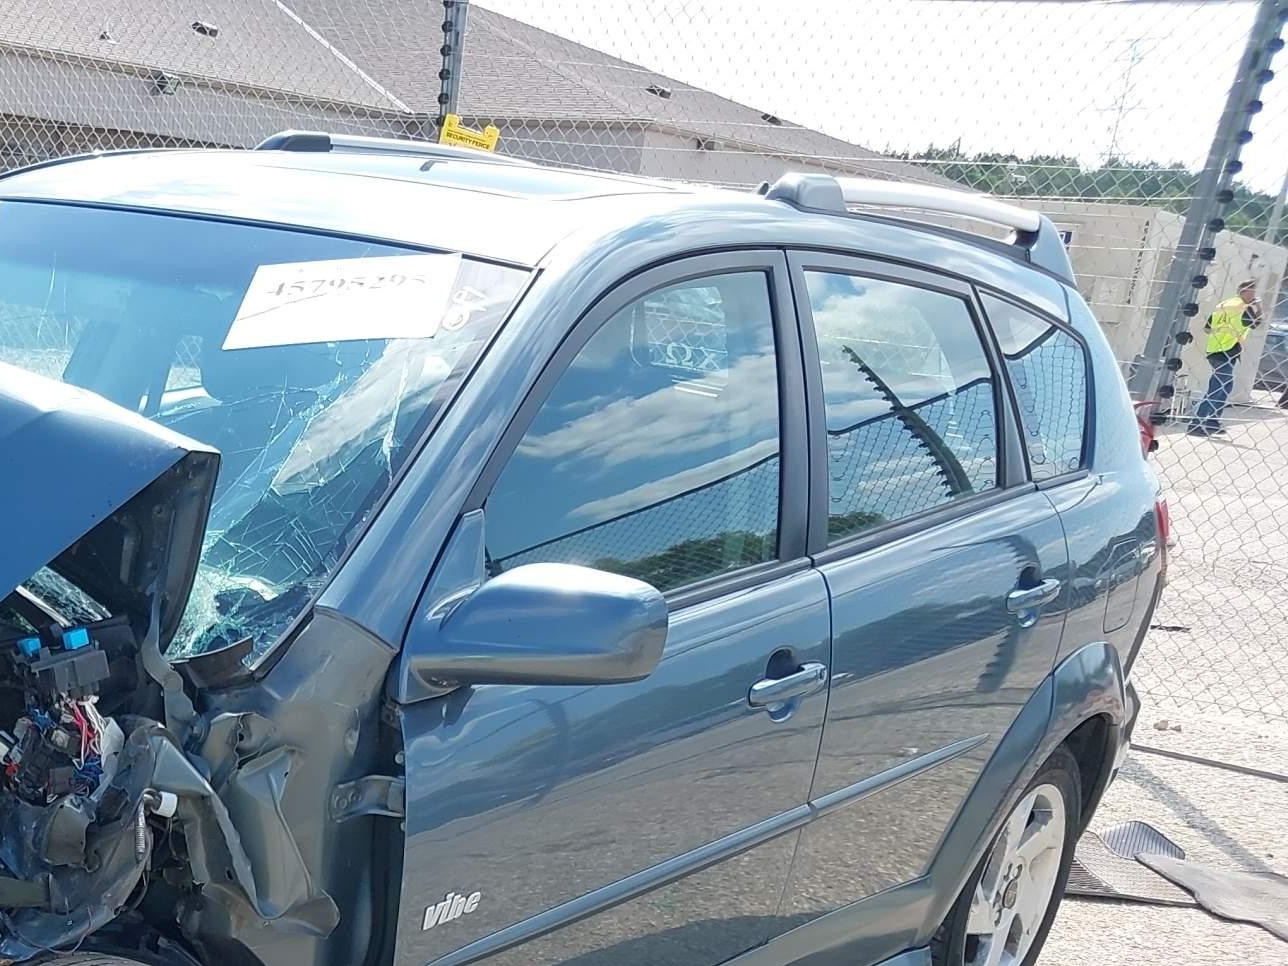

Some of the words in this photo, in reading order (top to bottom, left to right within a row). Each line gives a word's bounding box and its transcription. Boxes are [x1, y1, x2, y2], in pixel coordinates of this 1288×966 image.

[446, 131, 473, 145] SECURITY
[472, 139, 491, 150] FENCE
[422, 890, 482, 931] vibe
